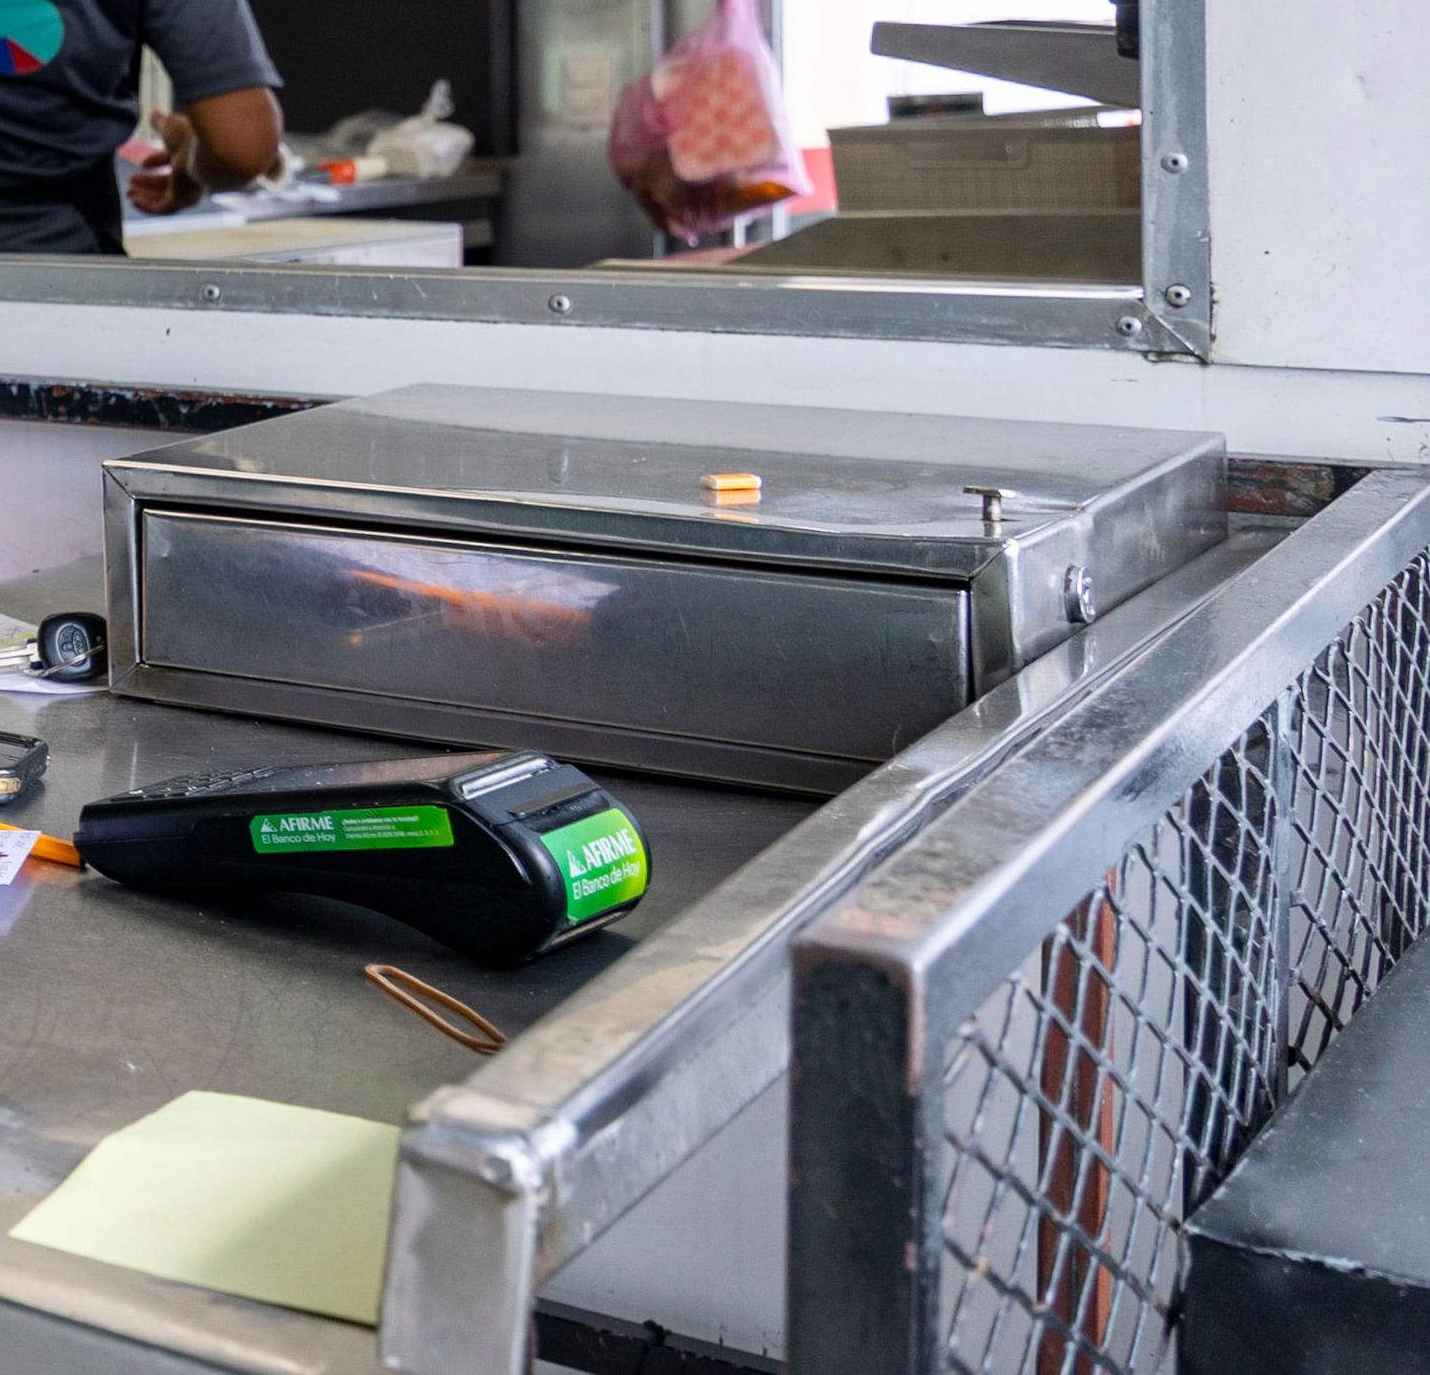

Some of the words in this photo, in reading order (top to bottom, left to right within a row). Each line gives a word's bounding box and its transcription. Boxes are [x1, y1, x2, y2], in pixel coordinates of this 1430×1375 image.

[279, 815, 335, 832] AFIRME
[261, 833, 271, 845] El
[271, 833, 302, 844] Banco
[302, 832, 317, 843] de
[317, 832, 336, 844] Hoy
[582, 828, 638, 872] AFIRME
[572, 880, 582, 901] El
[581, 874, 610, 897] Banco
[610, 865, 623, 885] de
[621, 861, 641, 880] Hoy
